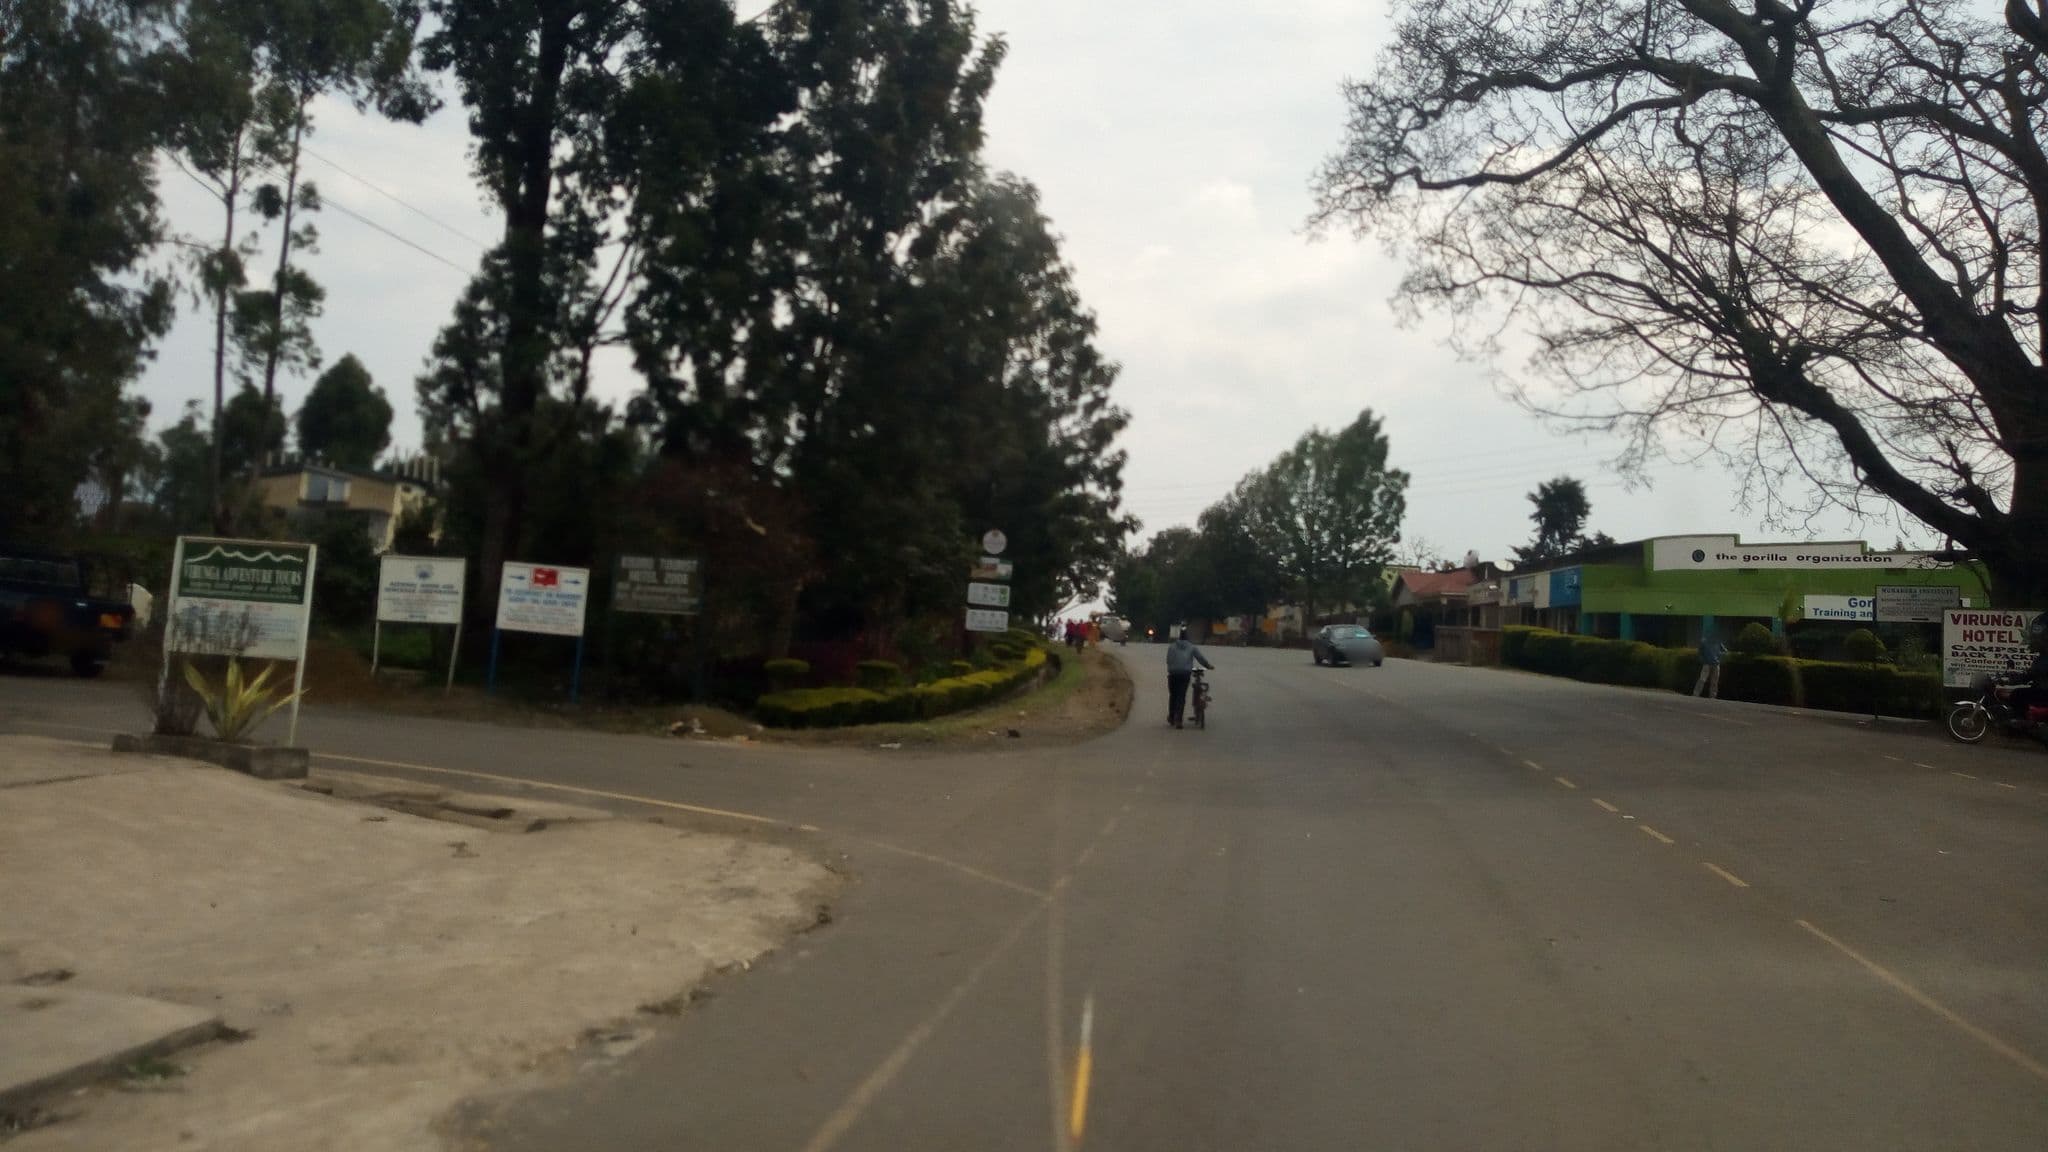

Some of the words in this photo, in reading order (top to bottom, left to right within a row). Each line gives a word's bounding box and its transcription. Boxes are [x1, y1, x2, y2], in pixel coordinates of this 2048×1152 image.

[1743, 553, 1787, 562] gorilla
[1796, 553, 1892, 563] organization
[1848, 597, 1873, 608] Gor
[1812, 607, 1857, 619] Training
[1951, 613, 2024, 628] VIRUNGA
[1962, 629, 2019, 644] HOTEL
[1951, 651, 1986, 659] BACK
[1964, 657, 2021, 666] Conferene
